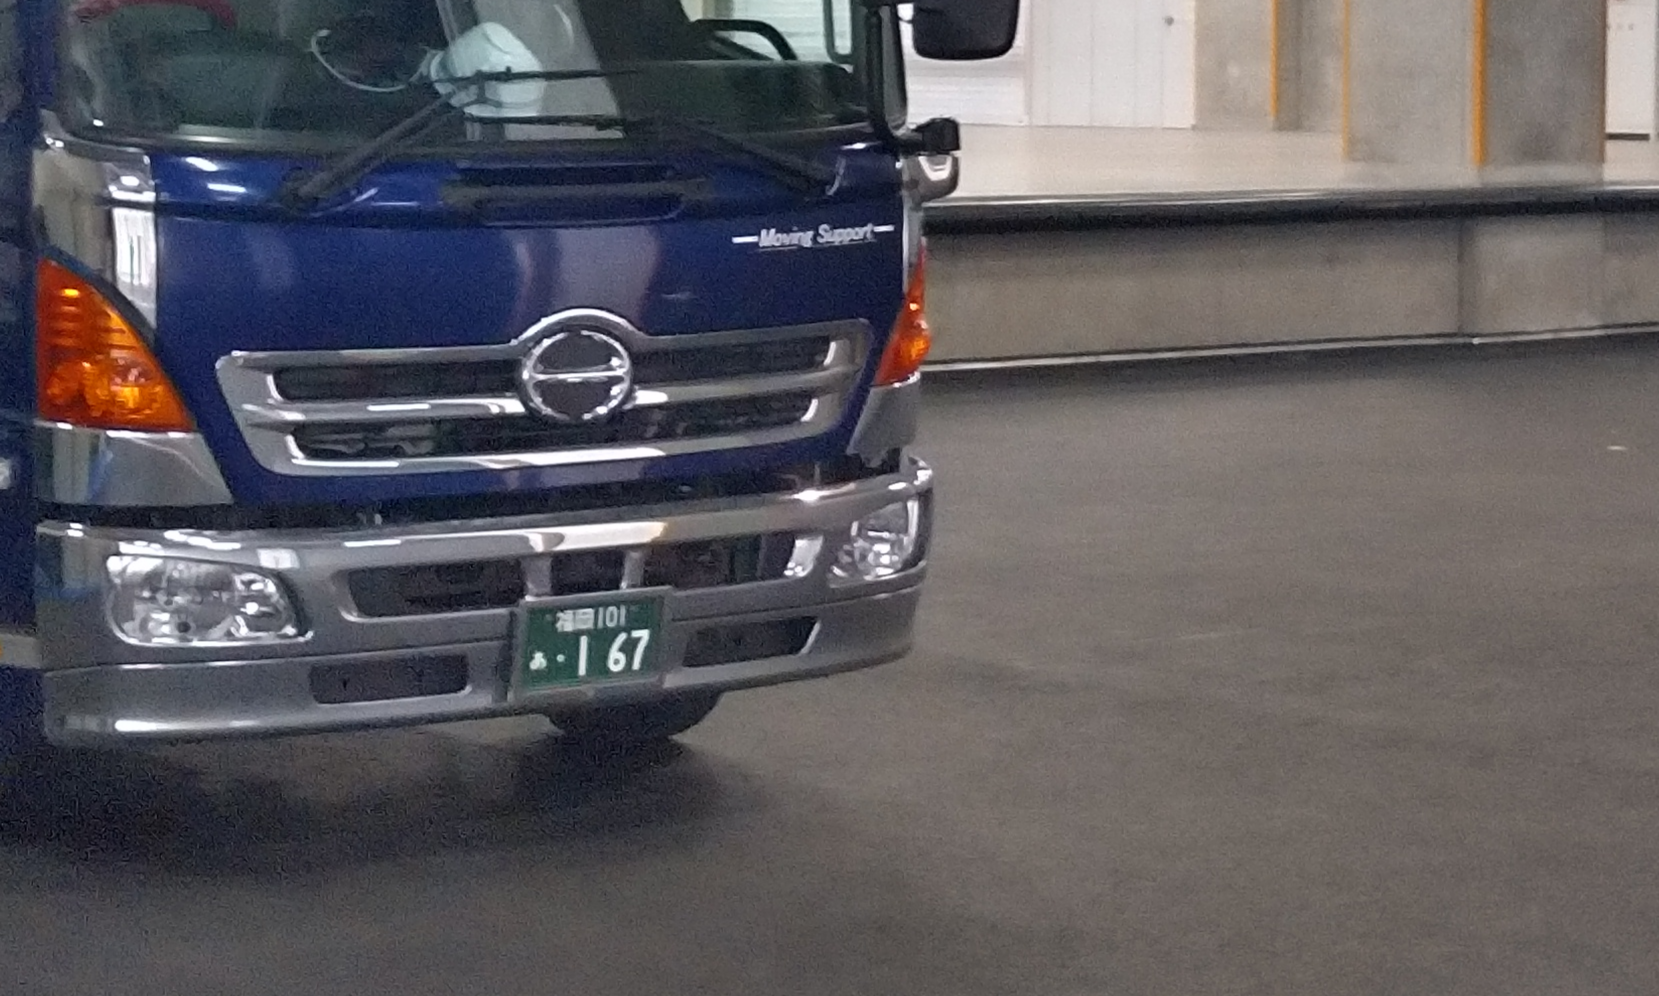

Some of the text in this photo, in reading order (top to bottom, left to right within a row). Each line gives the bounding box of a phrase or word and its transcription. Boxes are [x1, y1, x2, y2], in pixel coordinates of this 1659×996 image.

[758, 223, 875, 248] Moving Support
[598, 604, 627, 629] 101
